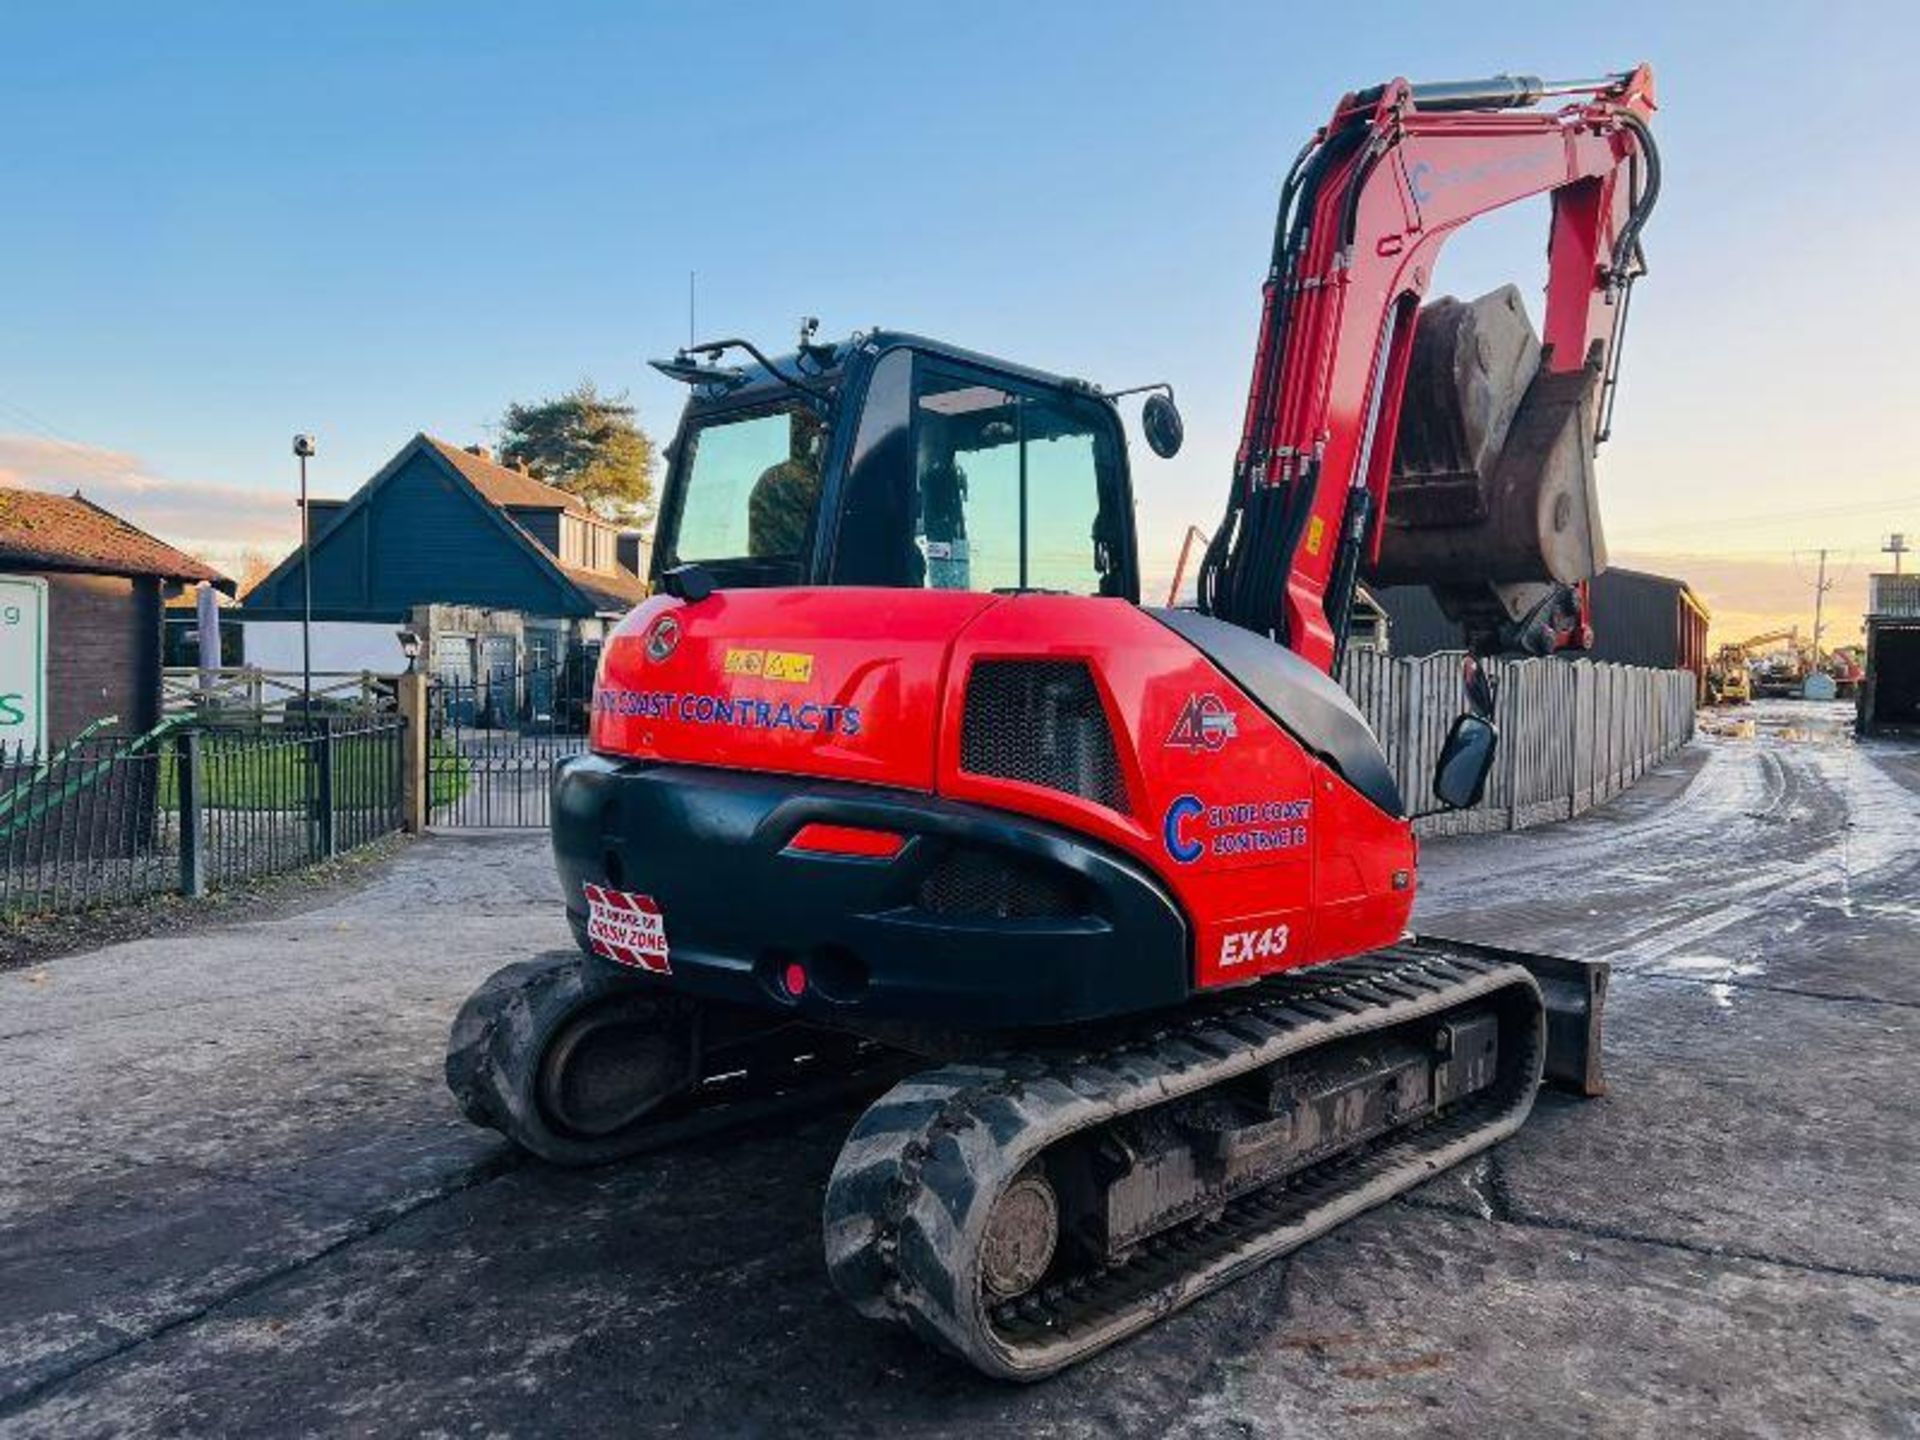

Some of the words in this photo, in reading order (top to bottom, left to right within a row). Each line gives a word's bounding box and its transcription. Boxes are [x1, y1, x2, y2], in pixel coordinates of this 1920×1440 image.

[680, 693, 861, 735] CONTRACTS
[1164, 794, 1205, 865] C
[629, 930, 666, 951] ZONE
[1219, 924, 1290, 968] EX43
